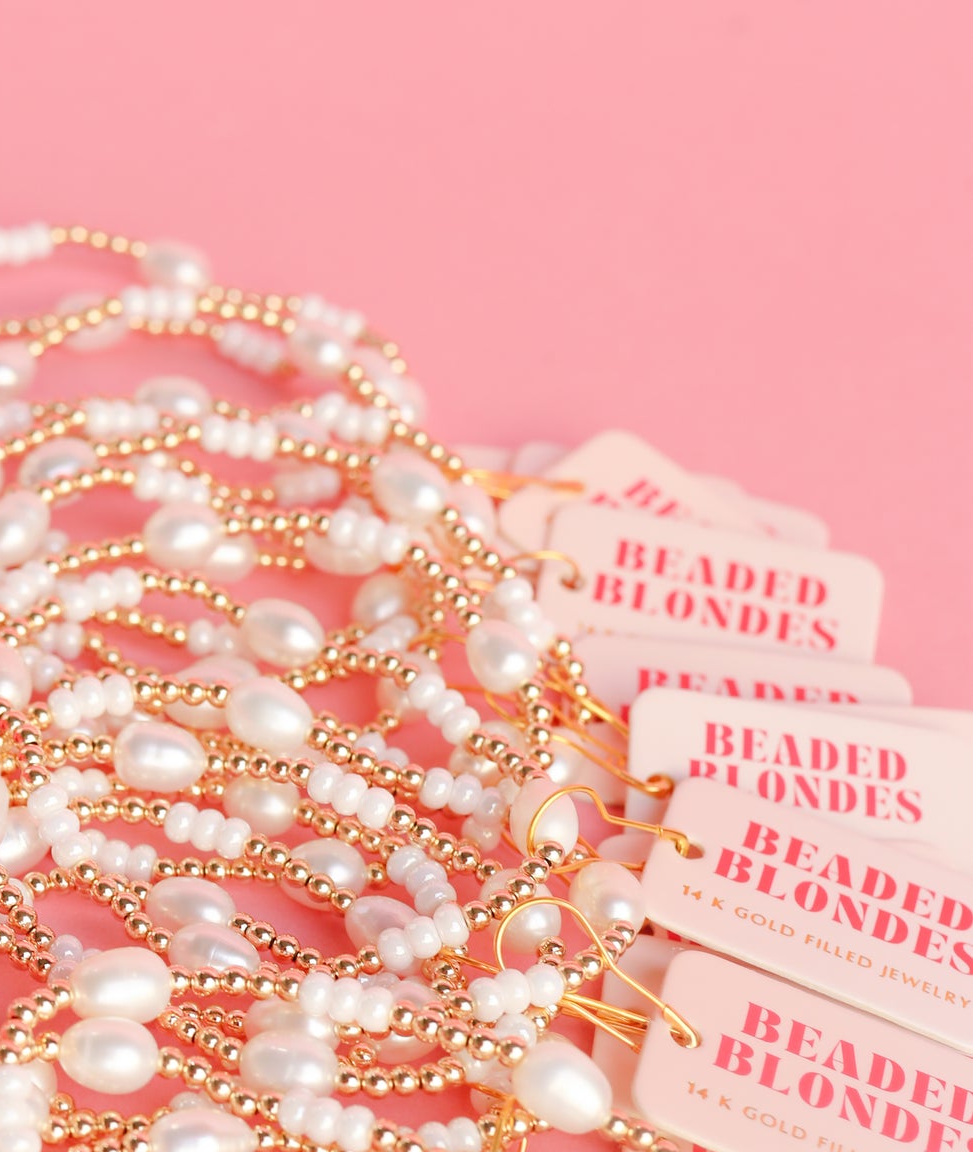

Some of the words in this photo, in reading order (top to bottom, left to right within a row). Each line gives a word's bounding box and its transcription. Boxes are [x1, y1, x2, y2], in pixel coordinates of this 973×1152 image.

[615, 539, 830, 607] BEADED
[592, 573, 840, 650] BLONDES
[704, 721, 908, 783] BEADED
[742, 820, 973, 932] BEADED
[682, 884, 703, 901] 14
[711, 896, 725, 910] K
[734, 905, 796, 938] GOLD
[804, 933, 873, 969] FILLED
[879, 964, 971, 1009] JEWELRY
[687, 1080, 708, 1100] 14
[719, 1095, 733, 1111] K
[742, 1105, 807, 1140] GOLD
